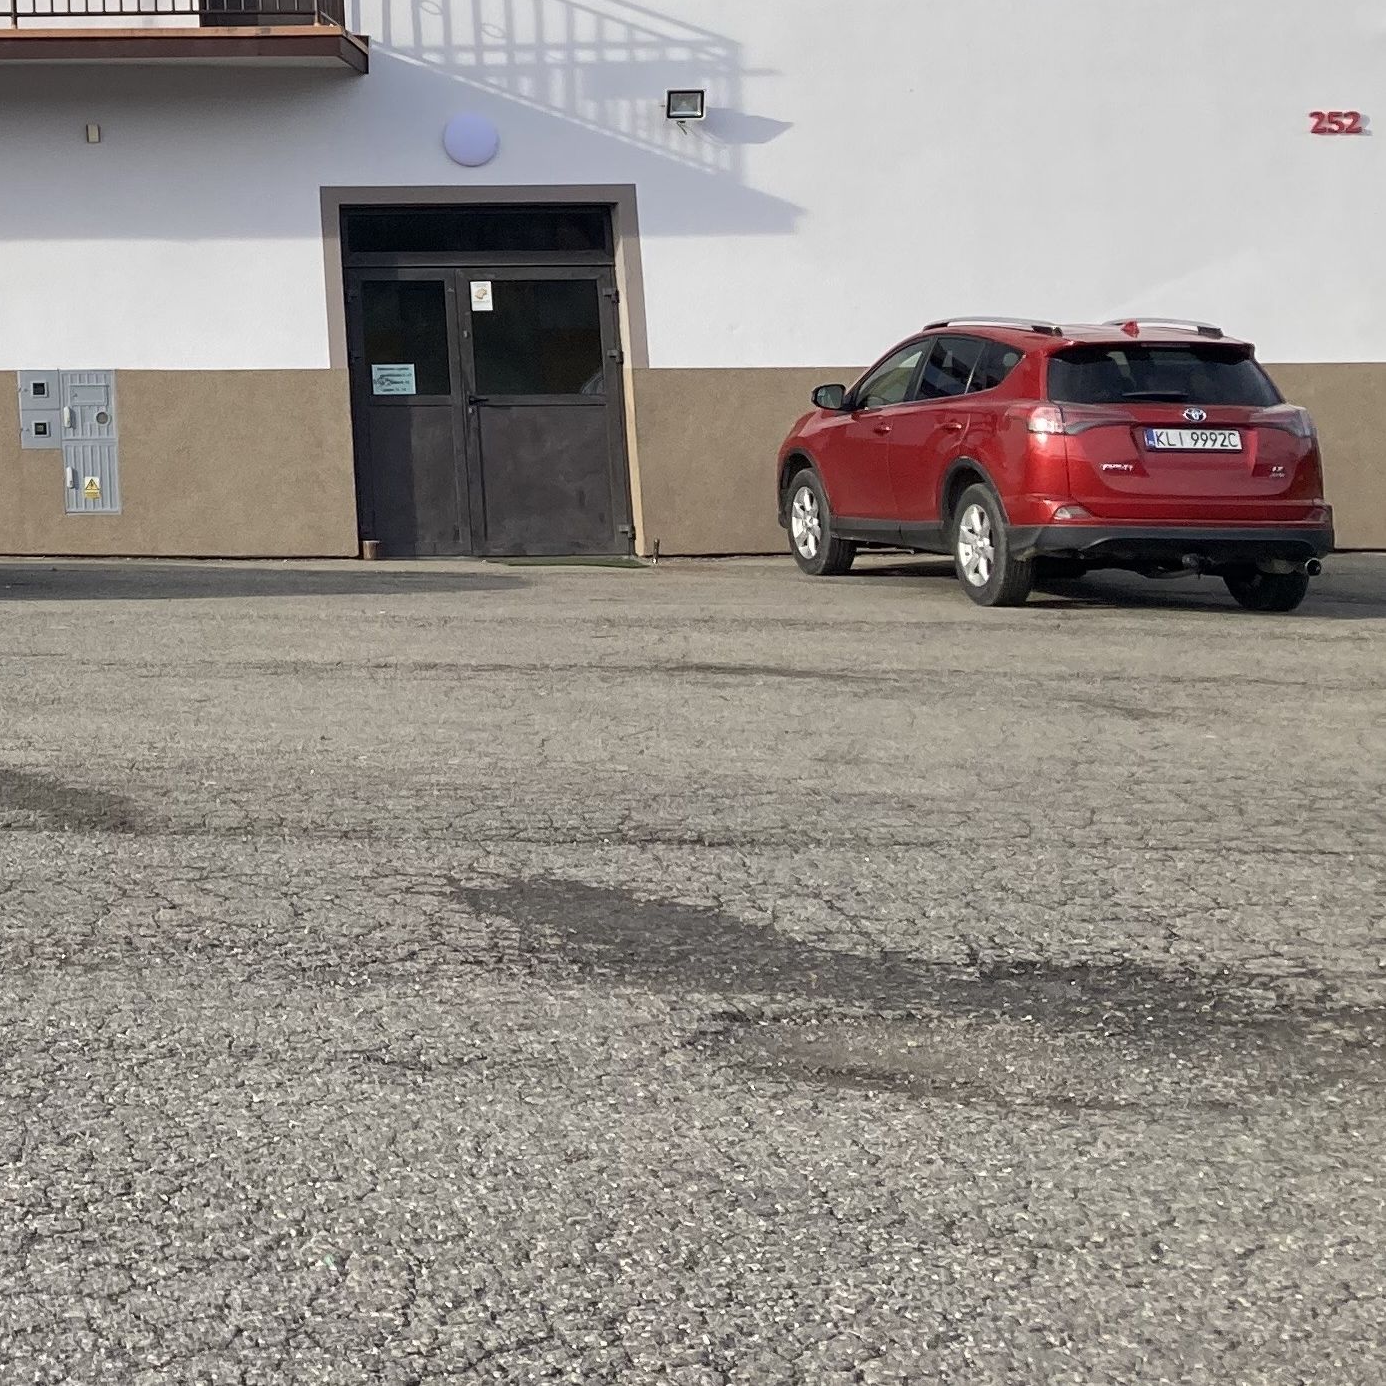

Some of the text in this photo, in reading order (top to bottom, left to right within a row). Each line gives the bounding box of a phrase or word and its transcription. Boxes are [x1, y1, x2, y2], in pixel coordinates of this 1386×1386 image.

[1309, 111, 1363, 134] 252
[1155, 432, 1239, 448] KLI 9992C
